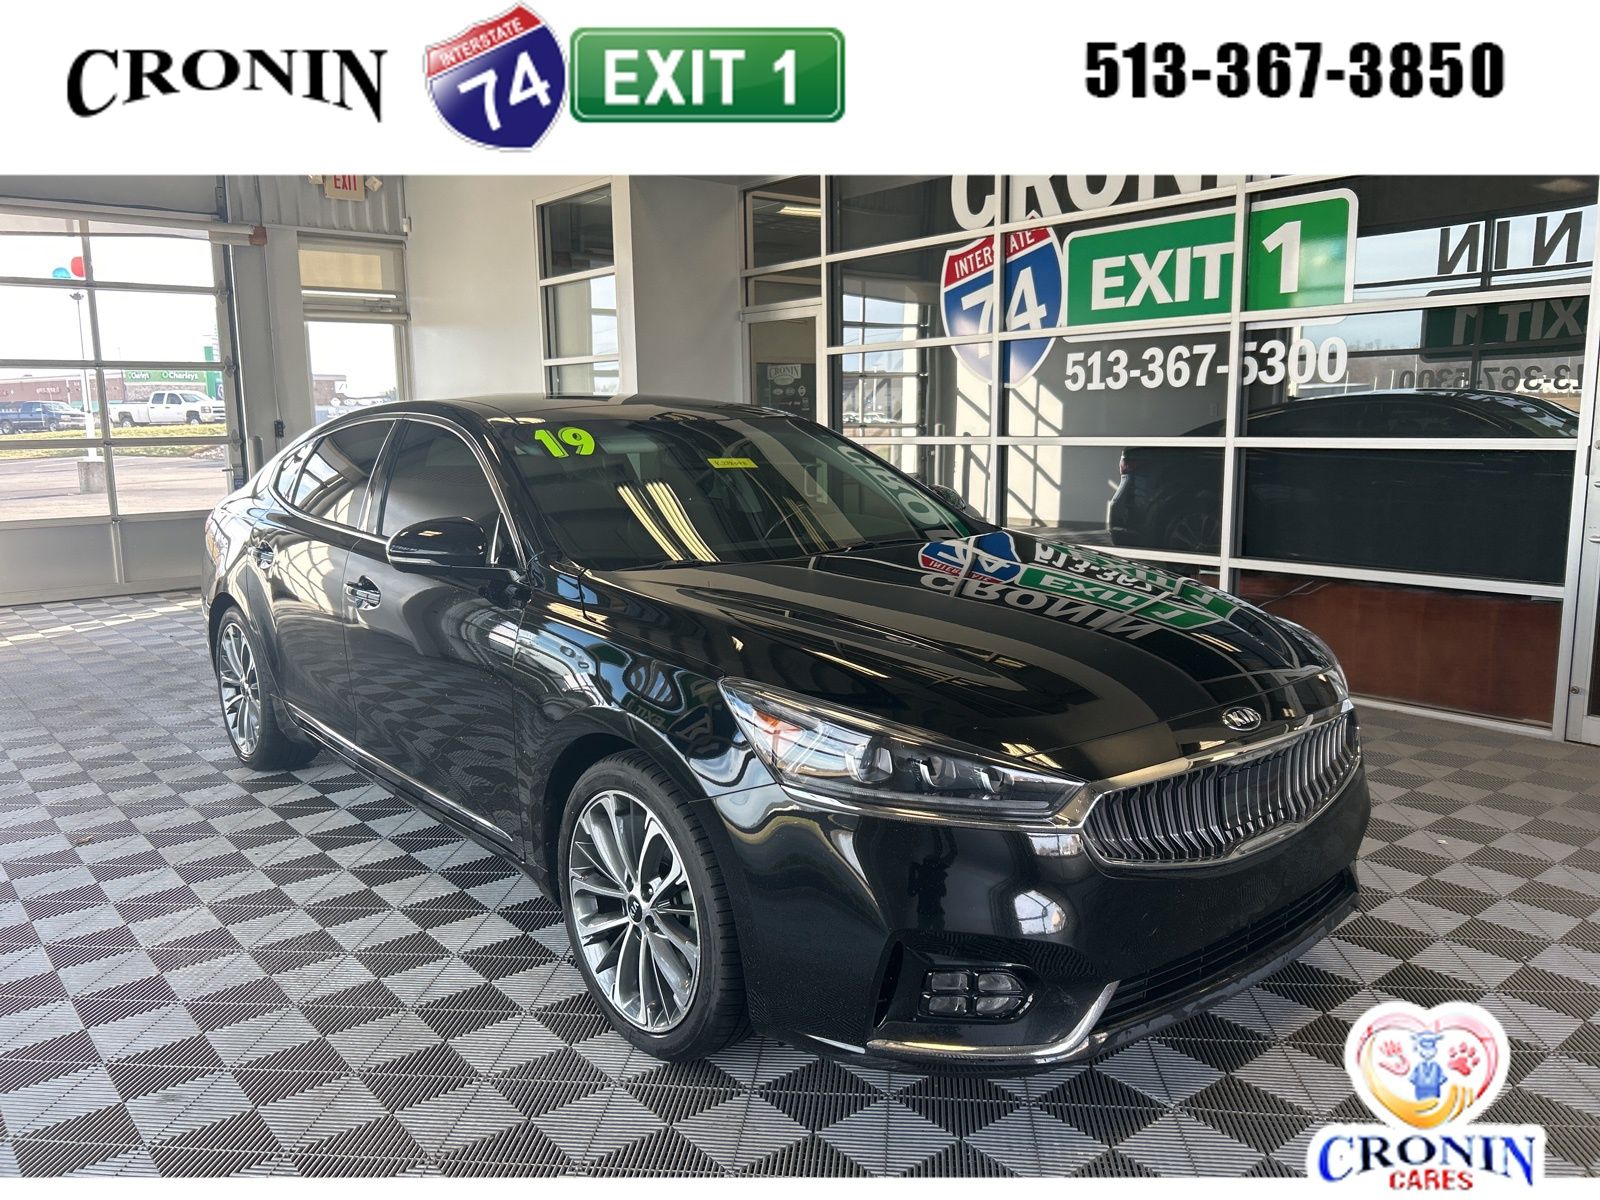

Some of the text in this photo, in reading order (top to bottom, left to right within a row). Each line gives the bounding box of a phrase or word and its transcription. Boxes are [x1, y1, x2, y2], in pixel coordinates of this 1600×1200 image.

[1091, 220, 1302, 311] EXIT 1
[961, 266, 1048, 358] 74
[1064, 337, 1348, 392] 513-367-5300
[535, 427, 596, 458] 19
